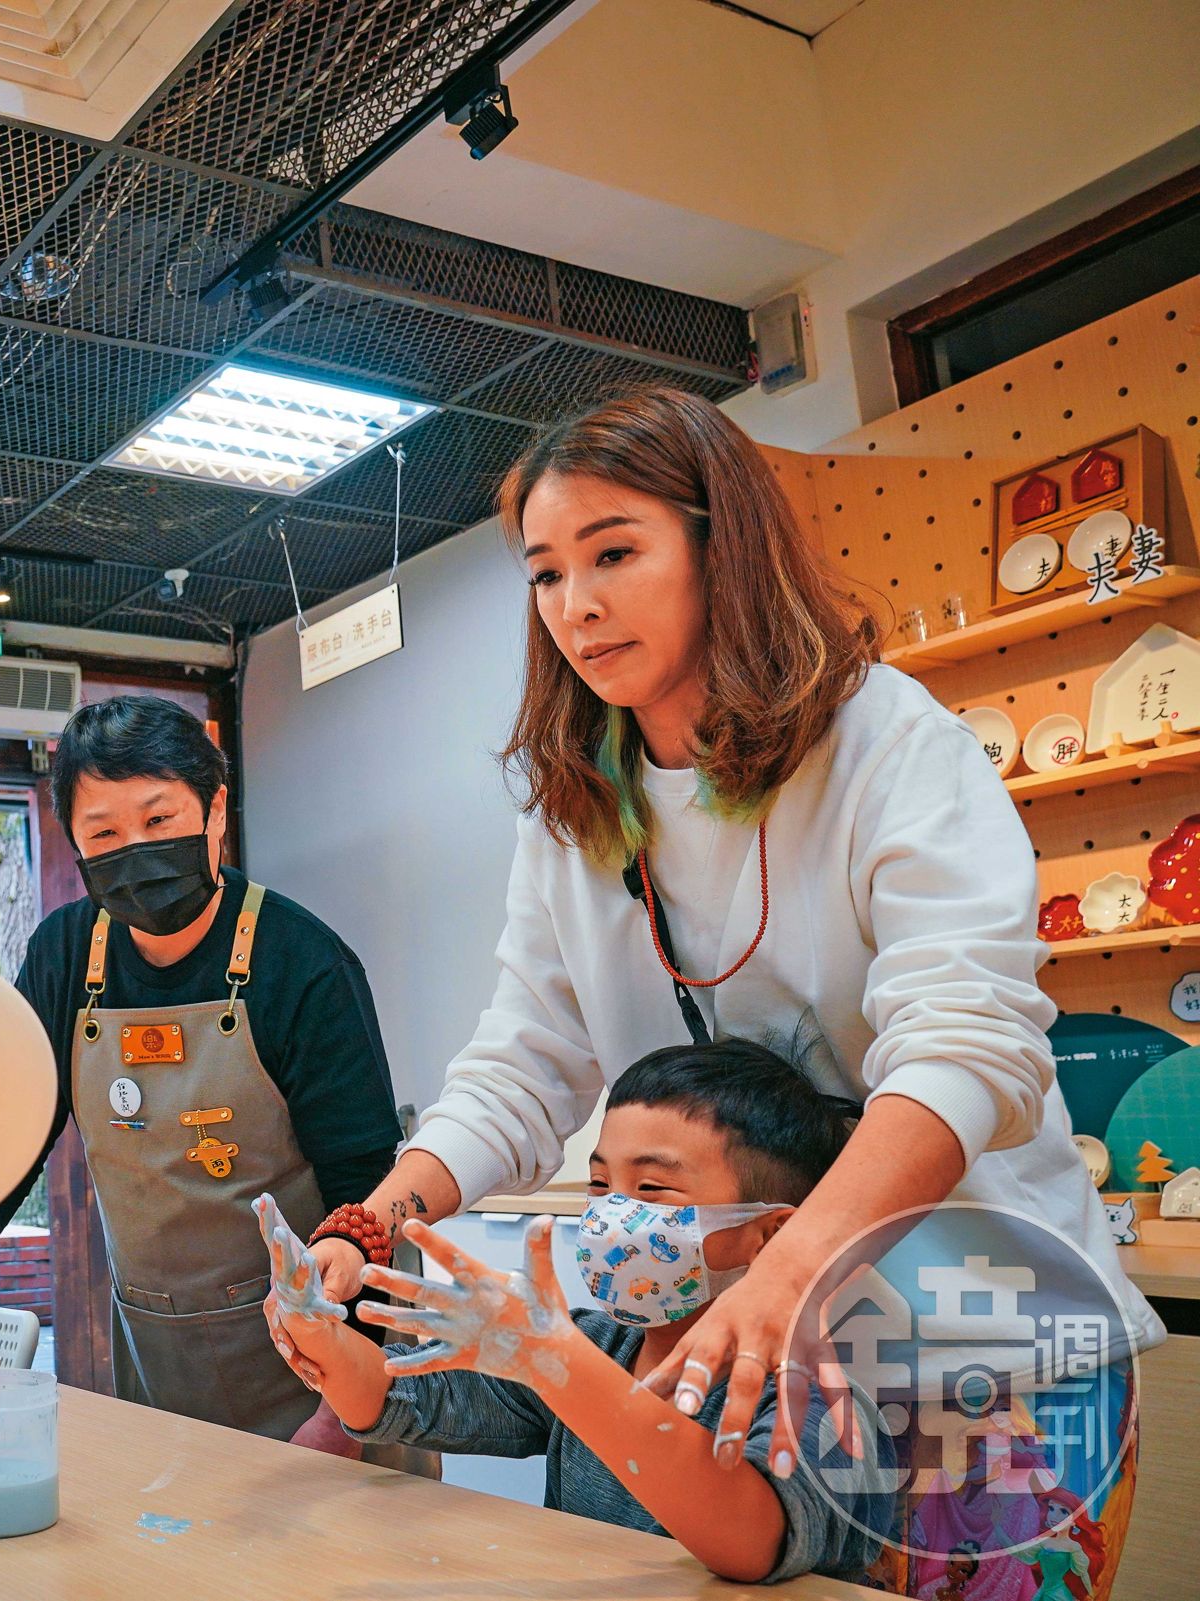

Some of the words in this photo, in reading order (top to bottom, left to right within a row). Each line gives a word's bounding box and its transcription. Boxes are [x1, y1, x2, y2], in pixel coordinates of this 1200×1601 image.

[353, 609, 392, 641] 洗手台
[1056, 742, 1077, 759] 胖
